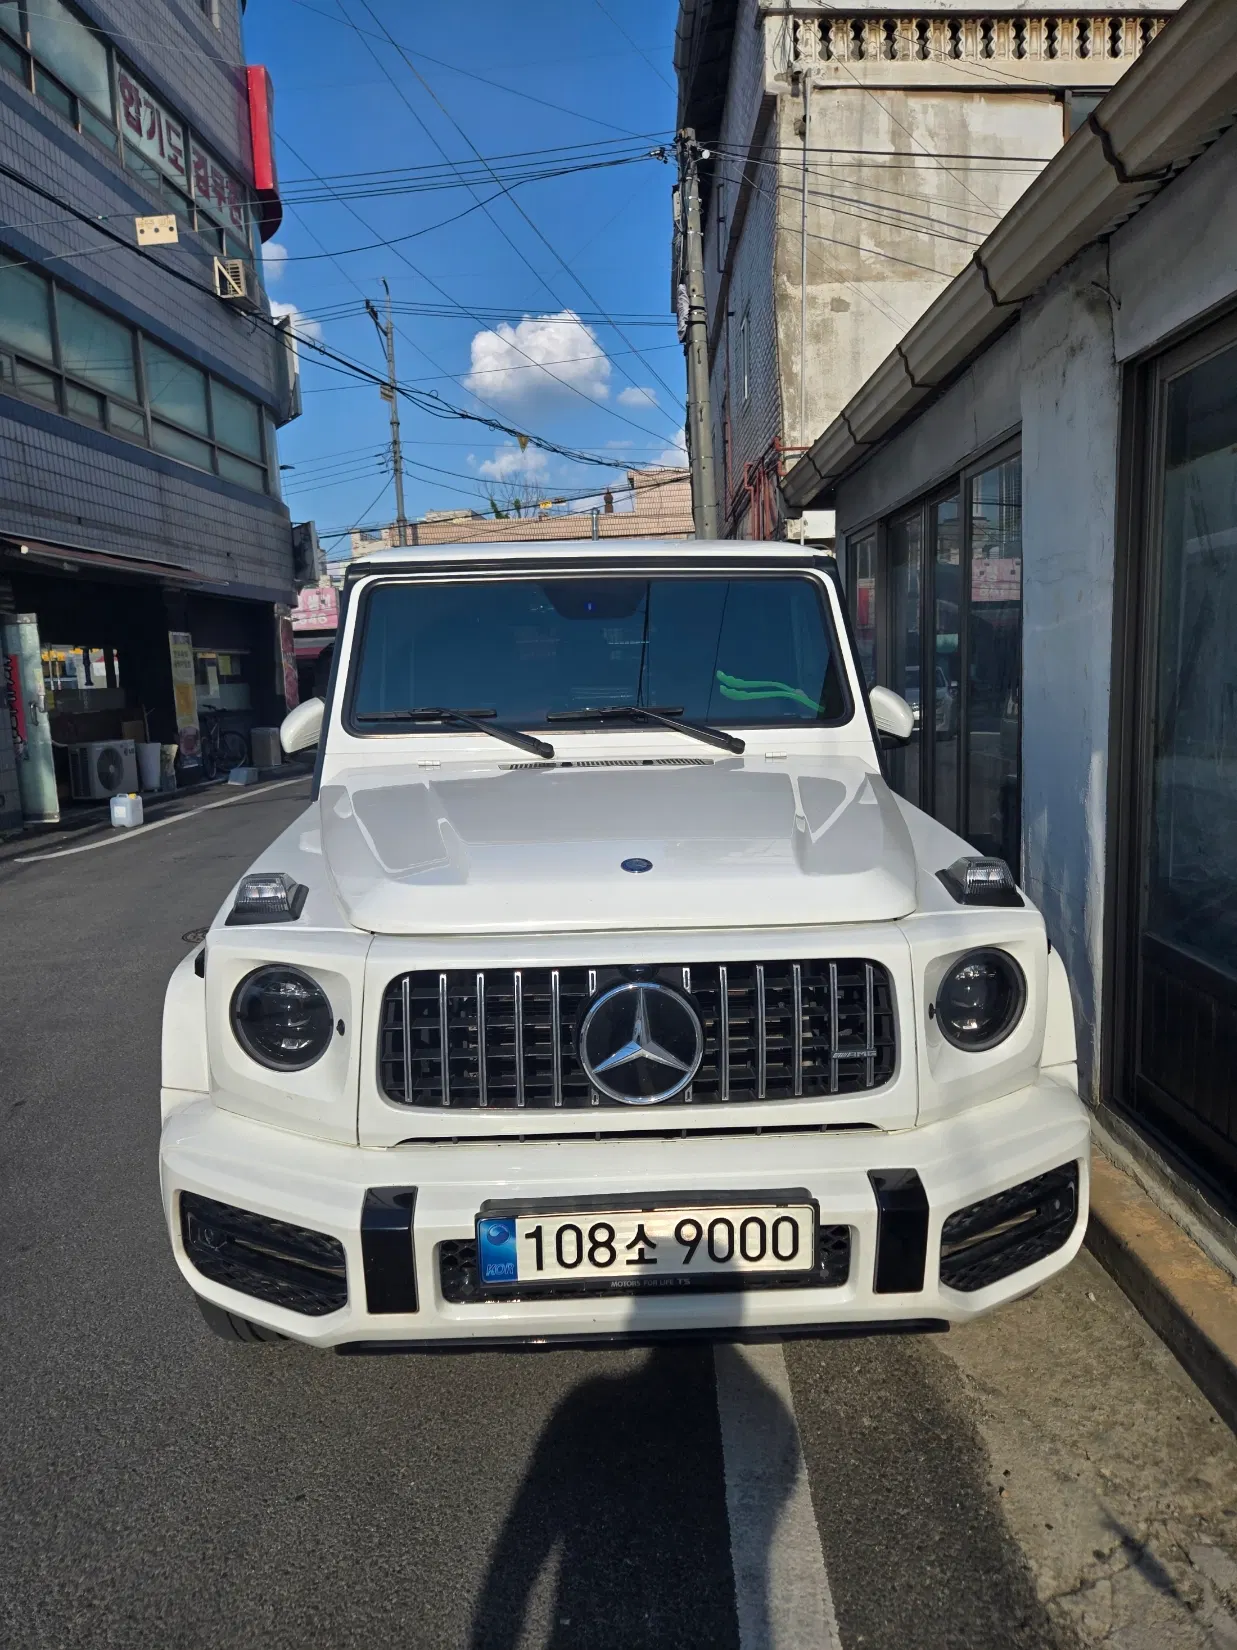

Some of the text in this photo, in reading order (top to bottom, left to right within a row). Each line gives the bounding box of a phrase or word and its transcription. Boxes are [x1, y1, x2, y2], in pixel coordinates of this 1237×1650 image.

[118, 71, 185, 175] 합기도
[524, 1214, 800, 1272] 108소 9000
[485, 1262, 515, 1277] KOR
[610, 1280, 640, 1288] MOTORS
